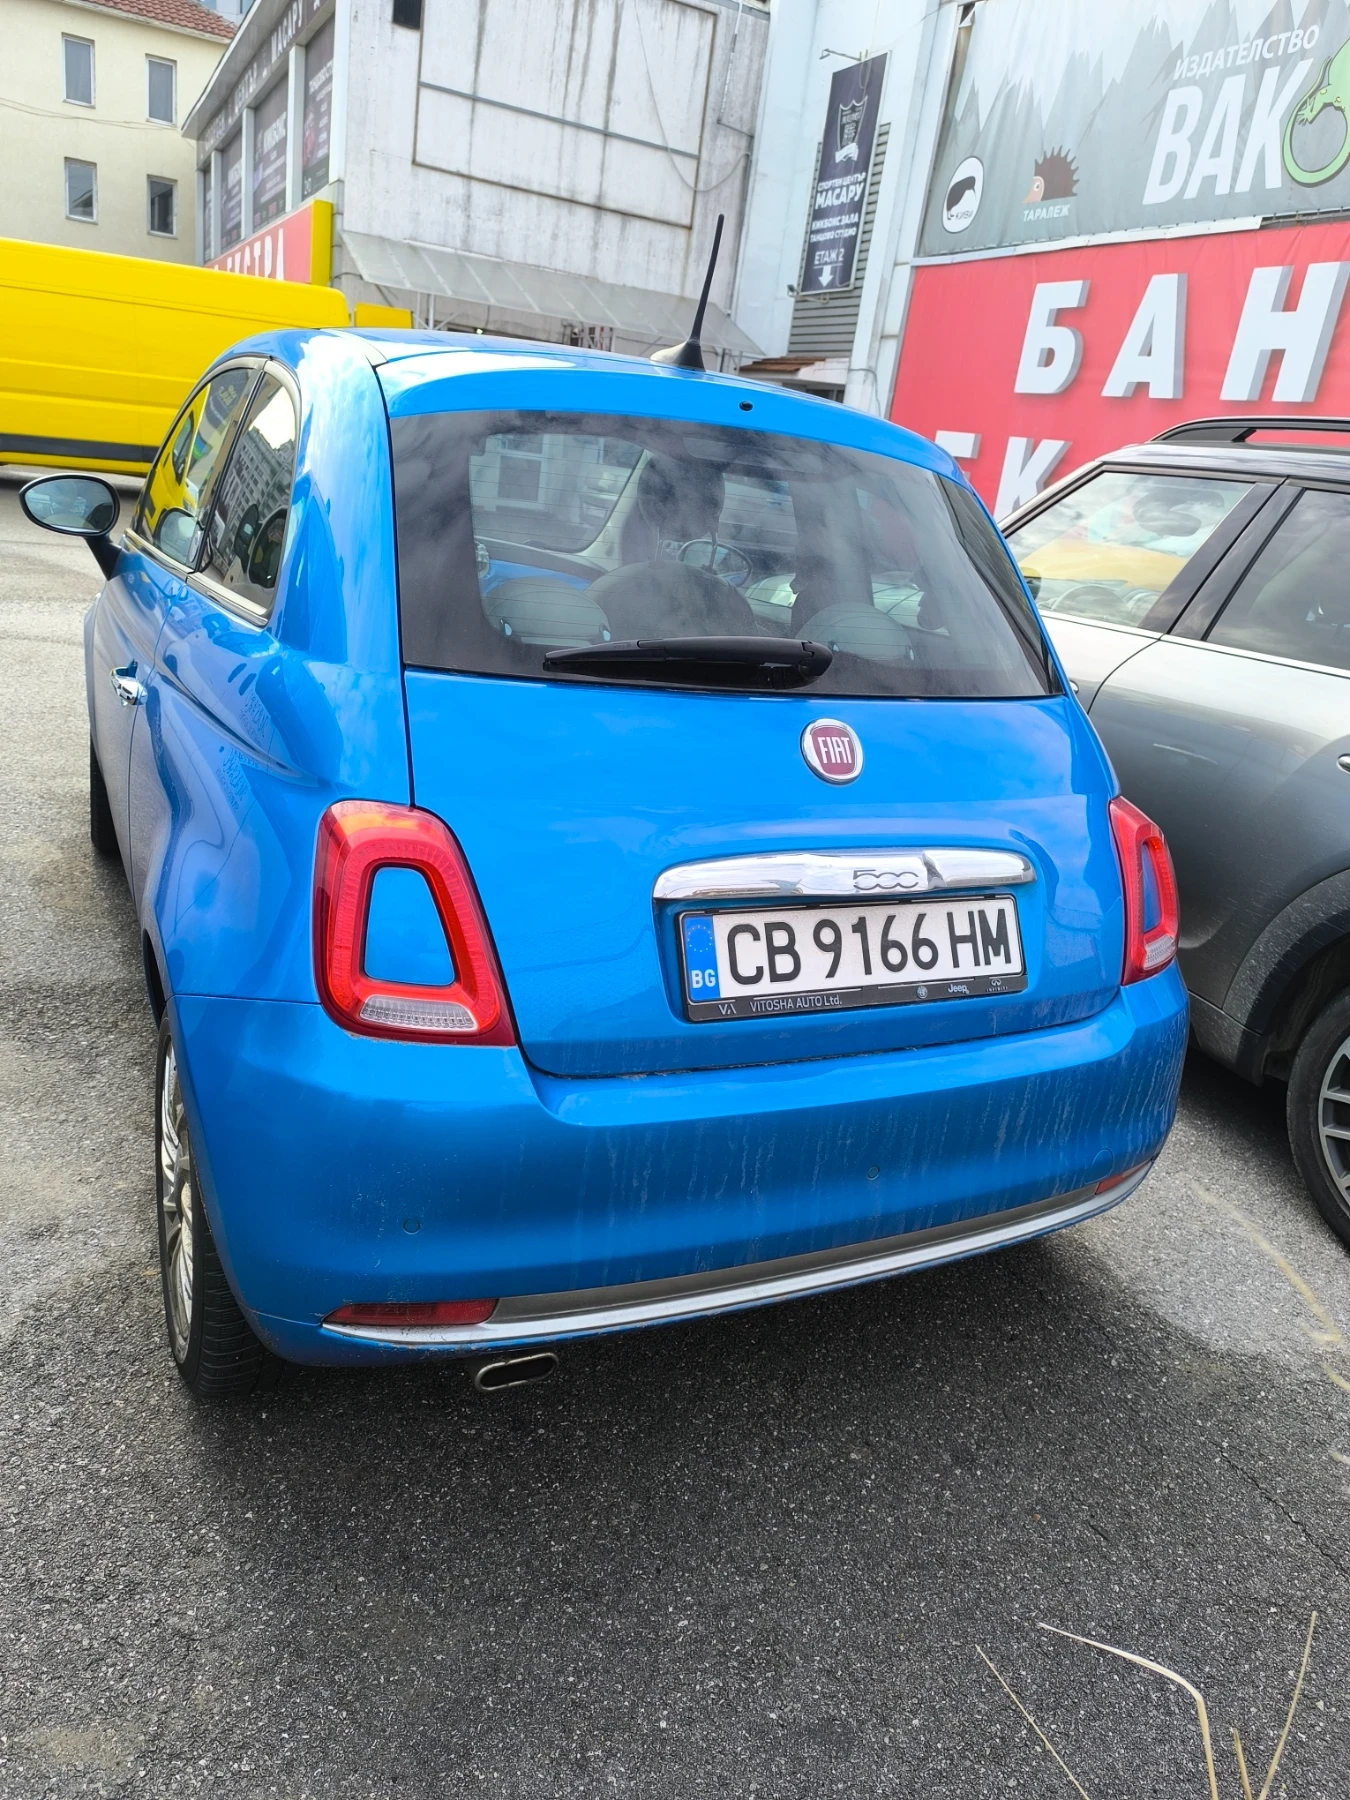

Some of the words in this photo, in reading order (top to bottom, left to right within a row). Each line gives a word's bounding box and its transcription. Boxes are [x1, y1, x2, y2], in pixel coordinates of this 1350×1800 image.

[1173, 24, 1320, 81] ИЗДАТЕЛСТВО
[814, 182, 865, 210] МАСАРУ
[1022, 204, 1072, 223] ТАРАЛЕЖ
[814, 249, 839, 265] ЕТАЖ
[838, 248, 846, 262] 2
[1014, 262, 1350, 403] БАН
[817, 736, 853, 764] FIAT
[727, 921, 802, 986] CB
[812, 912, 940, 980] 9166
[946, 908, 1012, 969] HM
[691, 968, 716, 989] BG
[947, 983, 969, 994] Jeep
[750, 999, 794, 1012] VITOSHA
[796, 996, 822, 1009] AUTO
[824, 995, 843, 1006] Ltd.
